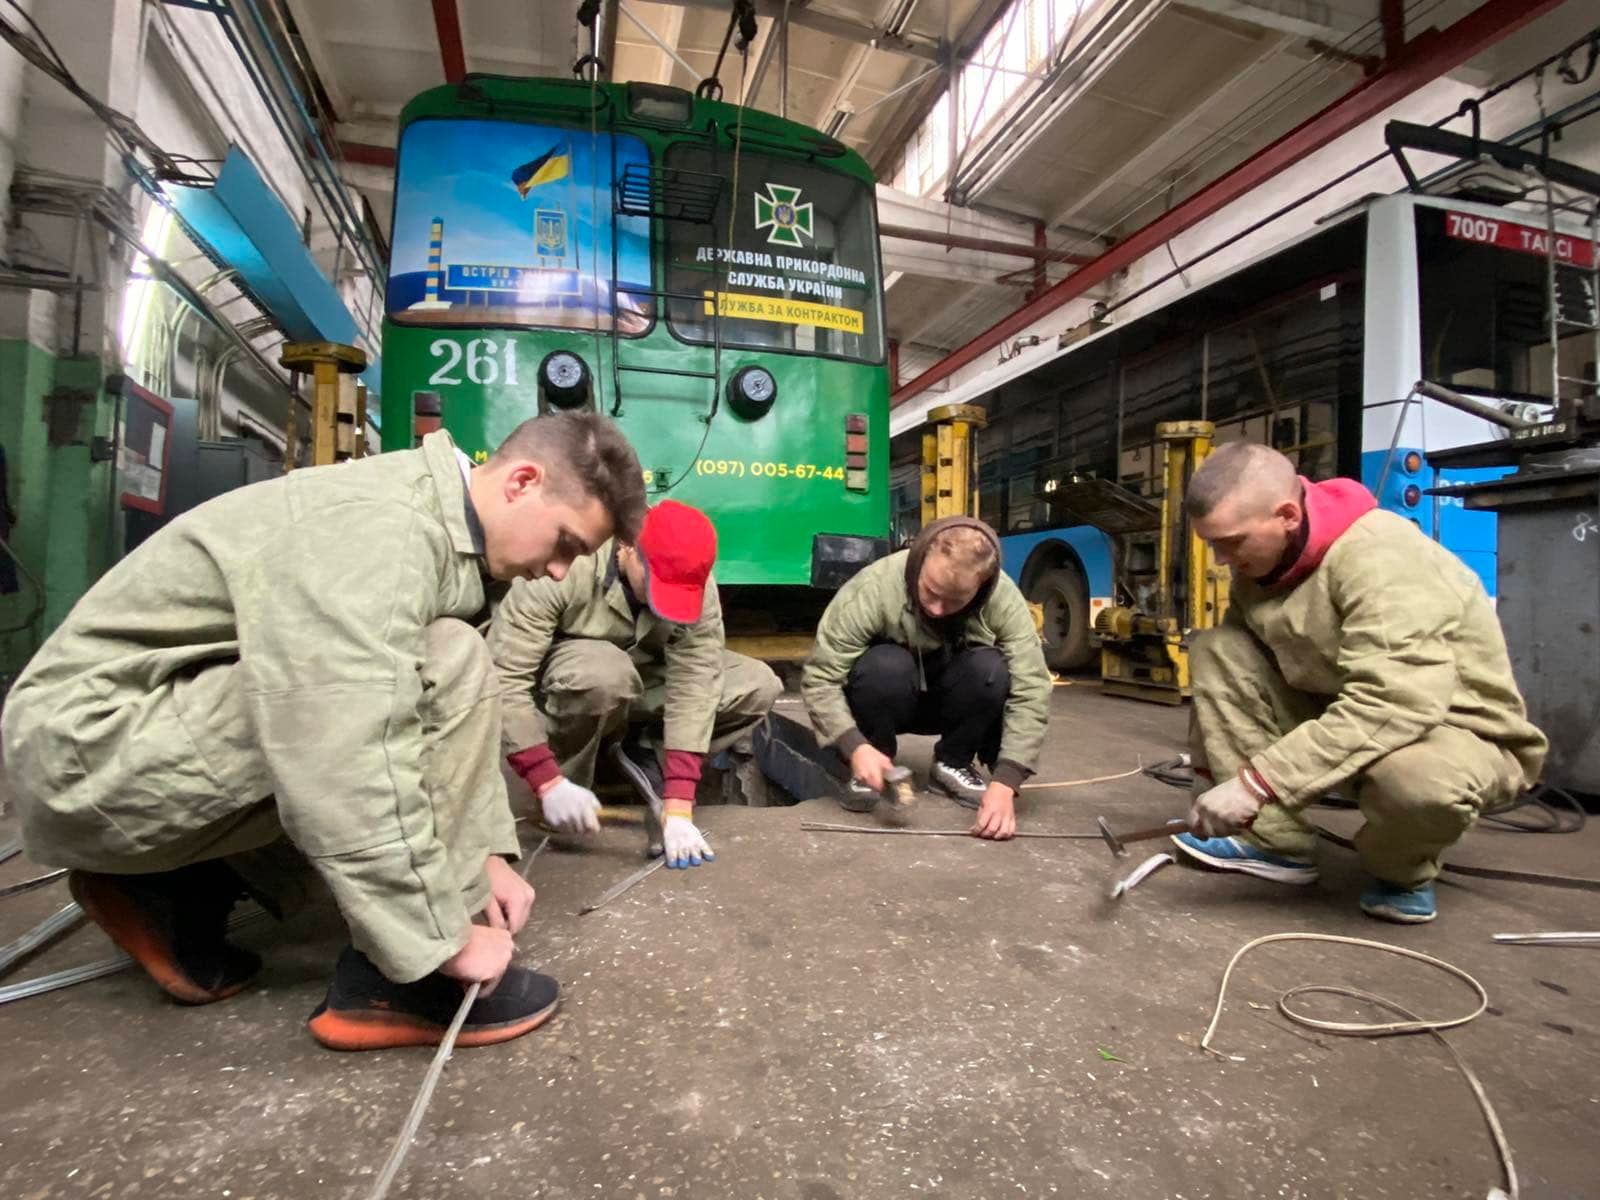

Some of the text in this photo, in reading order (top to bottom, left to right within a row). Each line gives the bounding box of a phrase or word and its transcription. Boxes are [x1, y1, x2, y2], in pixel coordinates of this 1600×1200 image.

[1450, 215, 1499, 243] 7007
[776, 256, 866, 284] ПРИКОРДОННА
[728, 271, 843, 299] СЛУЖБА УКРАЇНИ
[715, 300, 859, 328] ЛУЖБА ЗА КОНТРАКТОМ
[429, 339, 519, 385] 261
[696, 459, 844, 480] (097) 005-67-44
